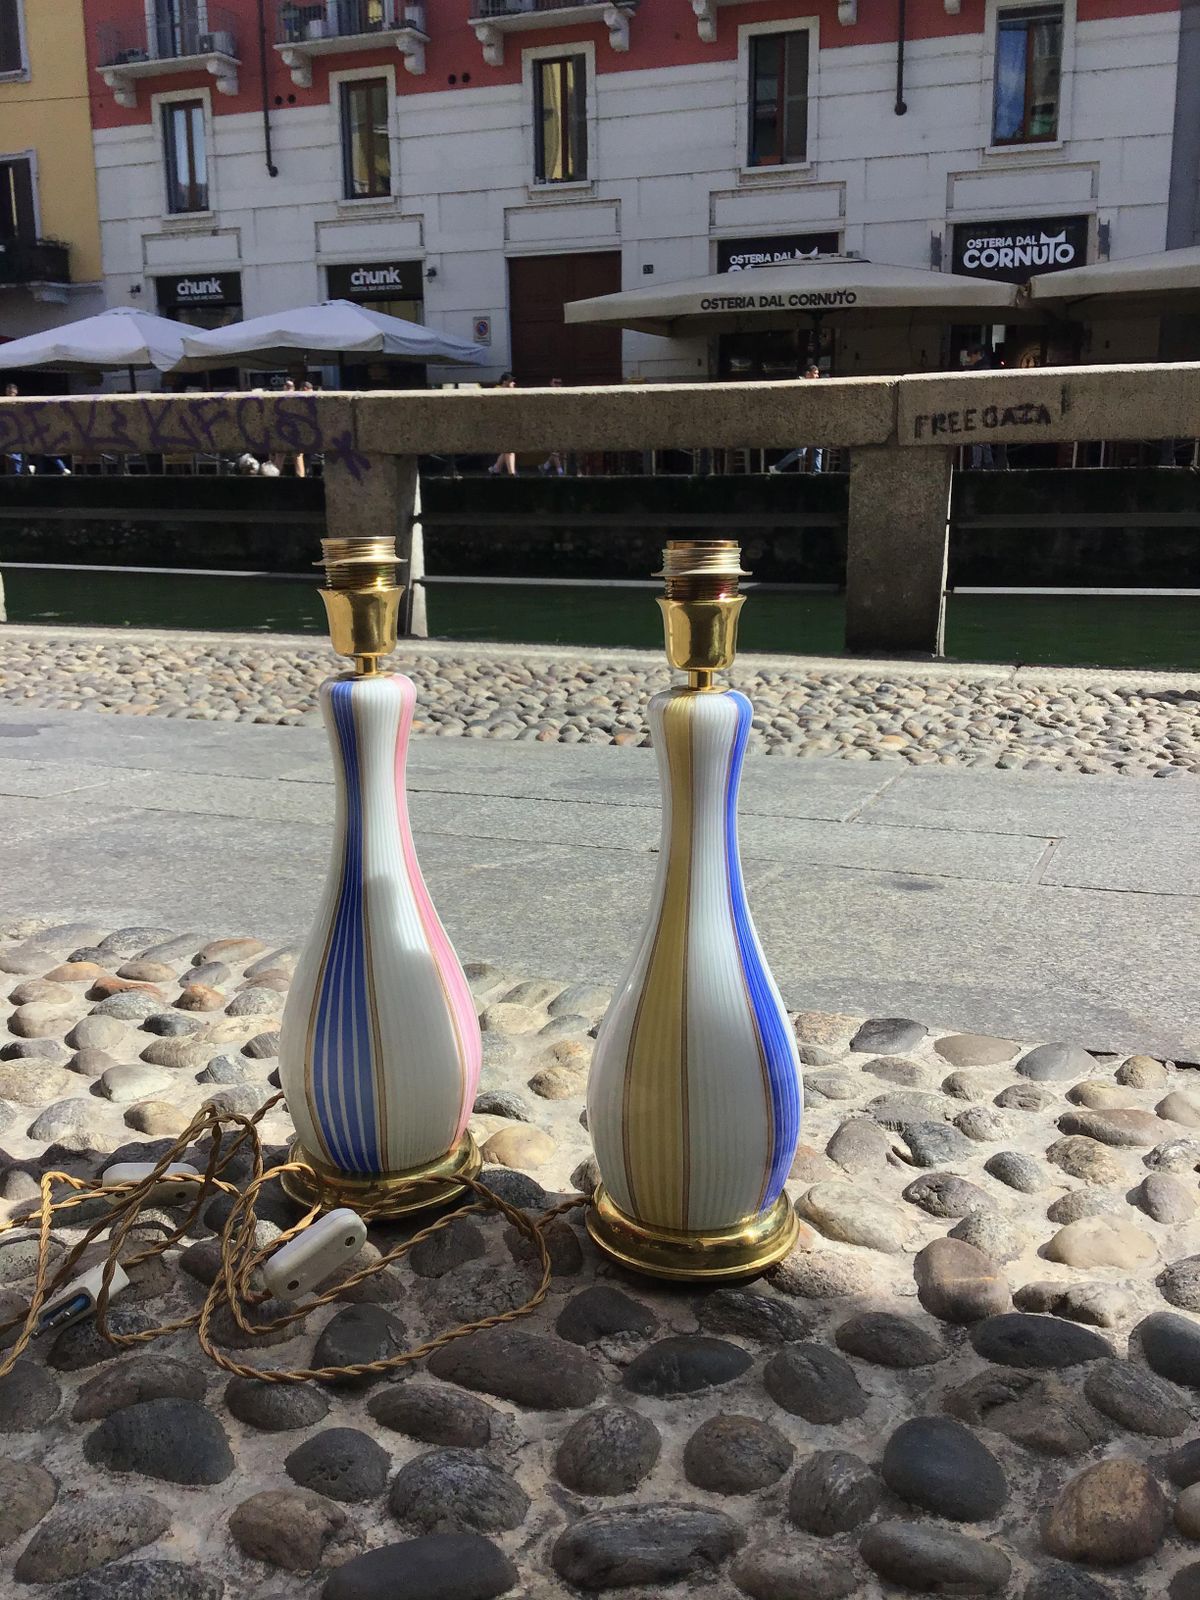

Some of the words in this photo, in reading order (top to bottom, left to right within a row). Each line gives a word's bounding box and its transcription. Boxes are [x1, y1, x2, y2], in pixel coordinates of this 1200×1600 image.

[963, 230, 1075, 269] CORNUTO
[966, 236, 1013, 249] OSTERIA
[1016, 235, 1038, 246] DAL
[729, 253, 772, 265] OSTERIA
[773, 251, 792, 262] DAL
[351, 266, 402, 285] chunk
[177, 277, 223, 295] chunk
[700, 296, 756, 310] OSTERIA
[759, 294, 785, 308] DAL
[788, 289, 857, 306] CORNUTO
[914, 408, 977, 439] FREE
